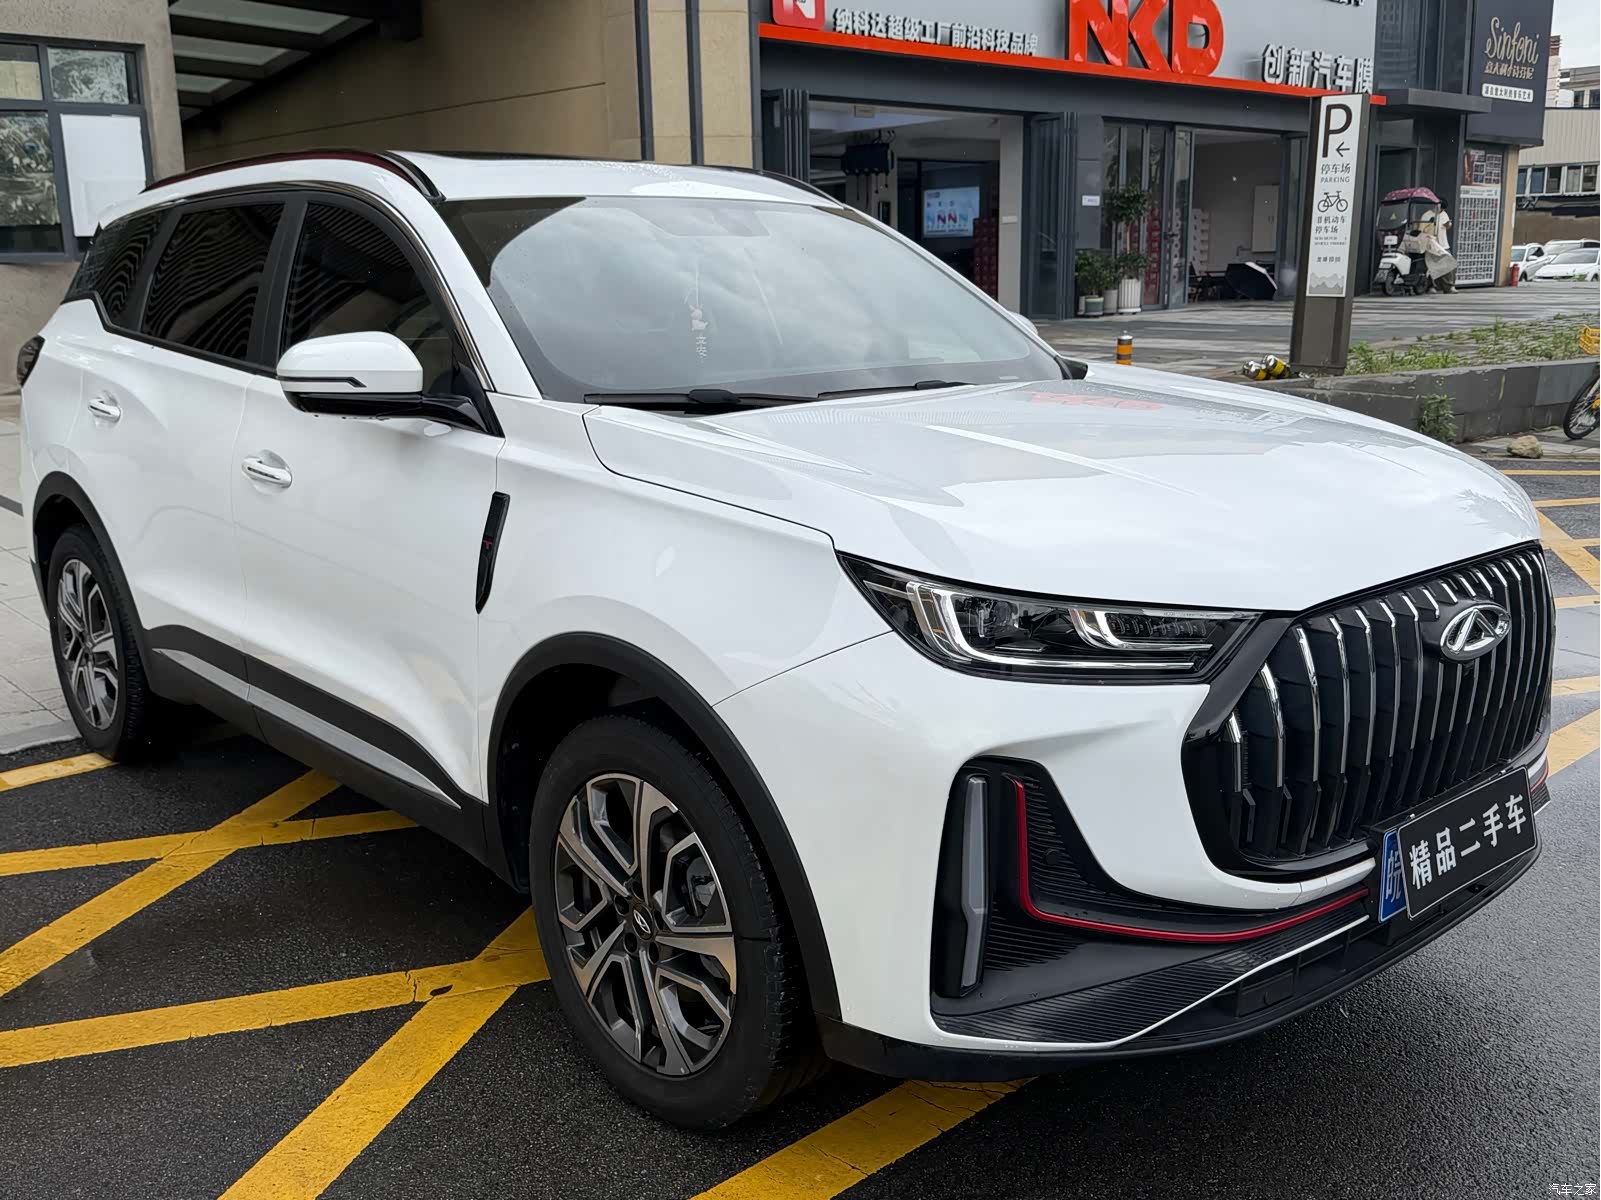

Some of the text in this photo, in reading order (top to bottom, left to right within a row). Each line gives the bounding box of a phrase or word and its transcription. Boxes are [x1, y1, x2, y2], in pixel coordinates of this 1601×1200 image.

[834, 8, 1039, 56] 纳科达超级工厂前沿科技品牌
[1068, 0, 1224, 77] NKD
[1484, 17, 1540, 68] Sinfoni
[1262, 43, 1374, 94] 创新汽车膜
[1322, 104, 1353, 158] P
[1320, 163, 1351, 175] 停车场
[1409, 794, 1526, 890] 精品二手车
